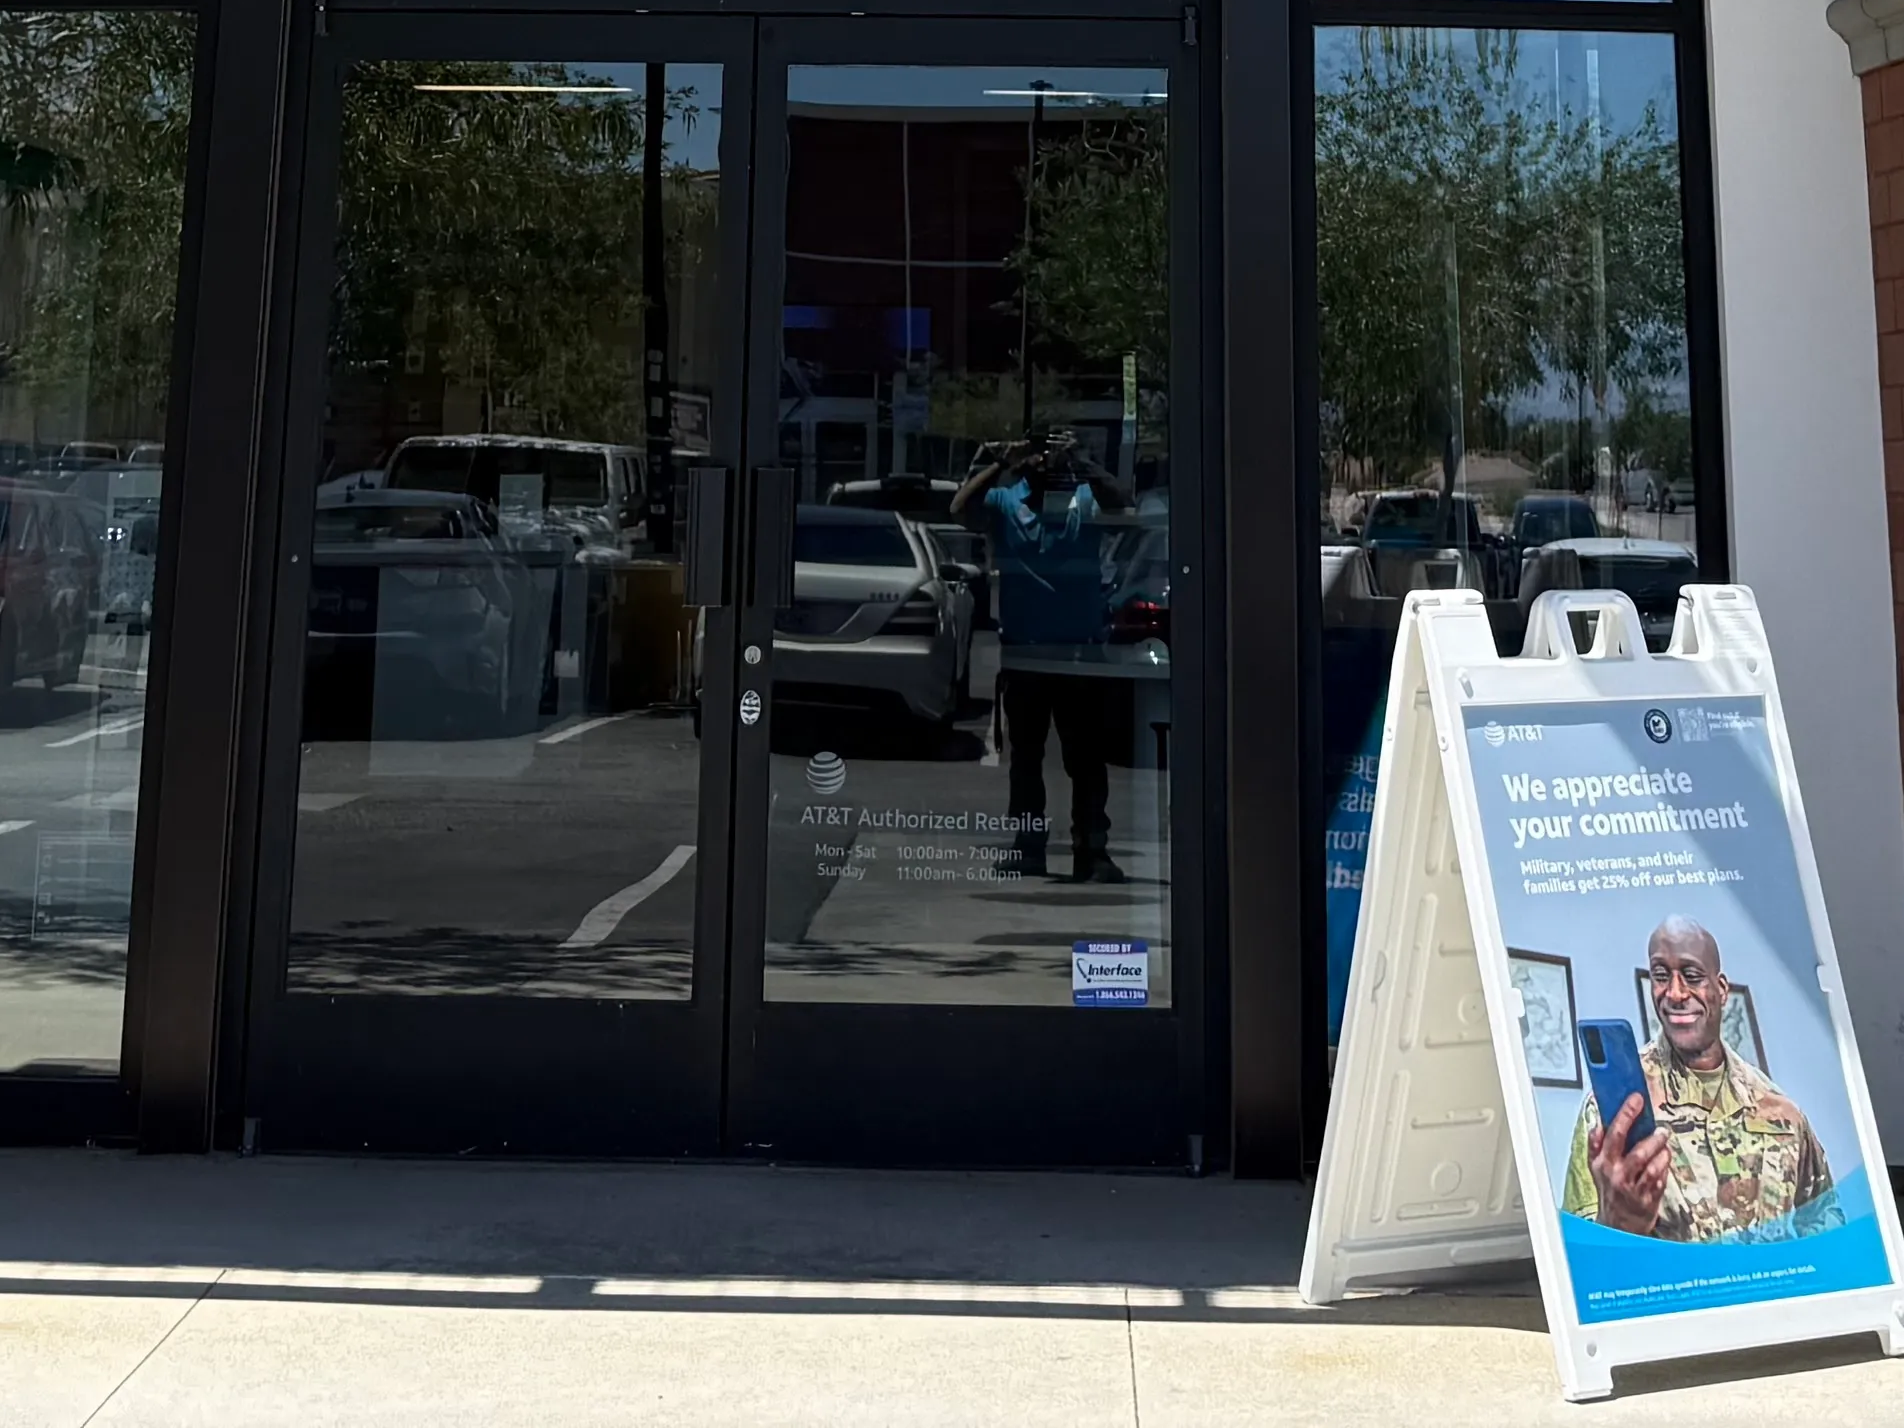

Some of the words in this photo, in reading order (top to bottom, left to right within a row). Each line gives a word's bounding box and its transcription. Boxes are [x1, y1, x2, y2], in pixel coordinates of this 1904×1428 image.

[1508, 724, 1543, 742] AT&T
[1501, 773, 1547, 802] We
[1552, 766, 1692, 807] appreciate
[800, 806, 853, 825] AT&T
[858, 808, 969, 830] Authorized
[975, 811, 1053, 832] Retailer
[1509, 814, 1572, 848] your
[1579, 802, 1748, 836] commitment
[815, 843, 845, 857] Mon
[855, 844, 877, 859] Sat
[968, 847, 1023, 863] 7:00pm
[1520, 859, 1575, 876] Military,
[1576, 855, 1636, 872] veterans,
[1638, 852, 1662, 868] and
[1663, 850, 1694, 866] their
[817, 863, 866, 880] Sunday
[1523, 877, 1576, 895] families
[1578, 877, 1600, 894] get
[1602, 874, 1629, 889] 25%
[1631, 872, 1653, 887] off
[1654, 873, 1675, 885] our
[1677, 869, 1704, 884] best
[1707, 868, 1744, 885] plans.
[1088, 964, 1142, 976] Interface
